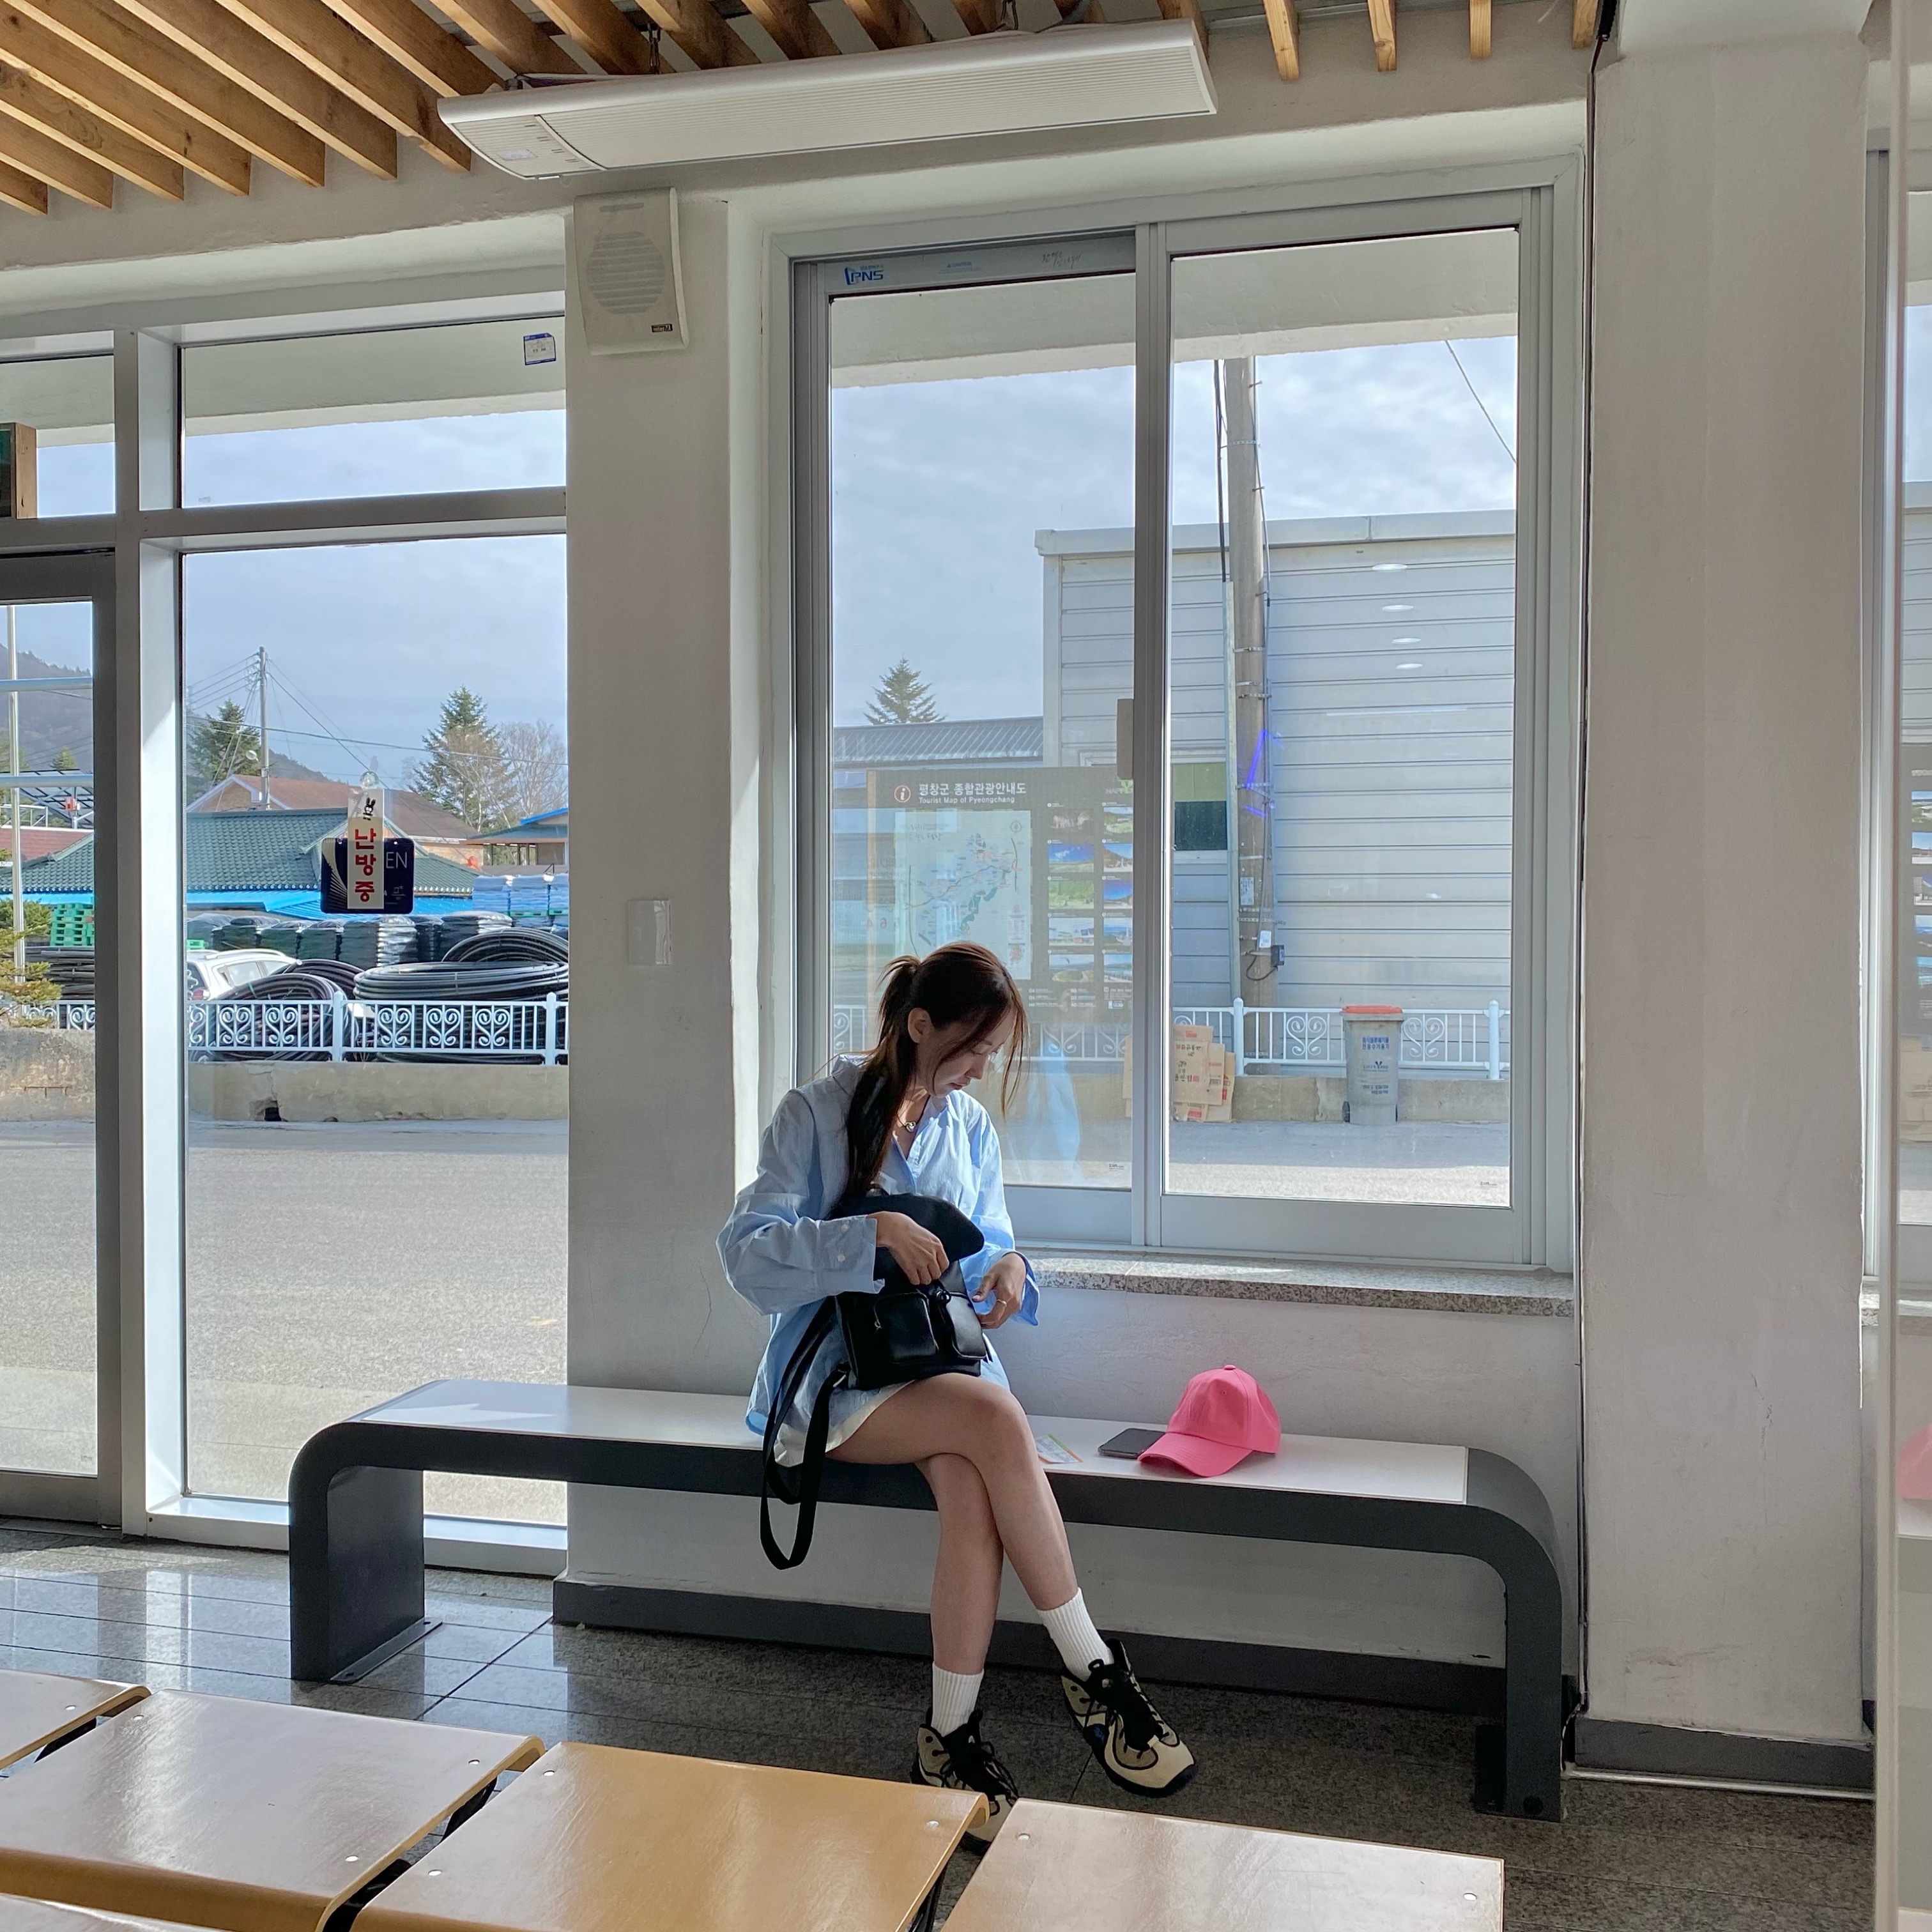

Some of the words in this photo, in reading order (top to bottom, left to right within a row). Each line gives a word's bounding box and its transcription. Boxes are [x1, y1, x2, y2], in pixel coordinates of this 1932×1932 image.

[850, 270, 884, 282] PNS
[919, 783, 949, 796] 평창군
[954, 782, 1027, 795] 종합관광안내도
[969, 796, 1015, 804] Pyeongchang
[355, 827, 377, 902] 난방중
[386, 852, 408, 869] EN
